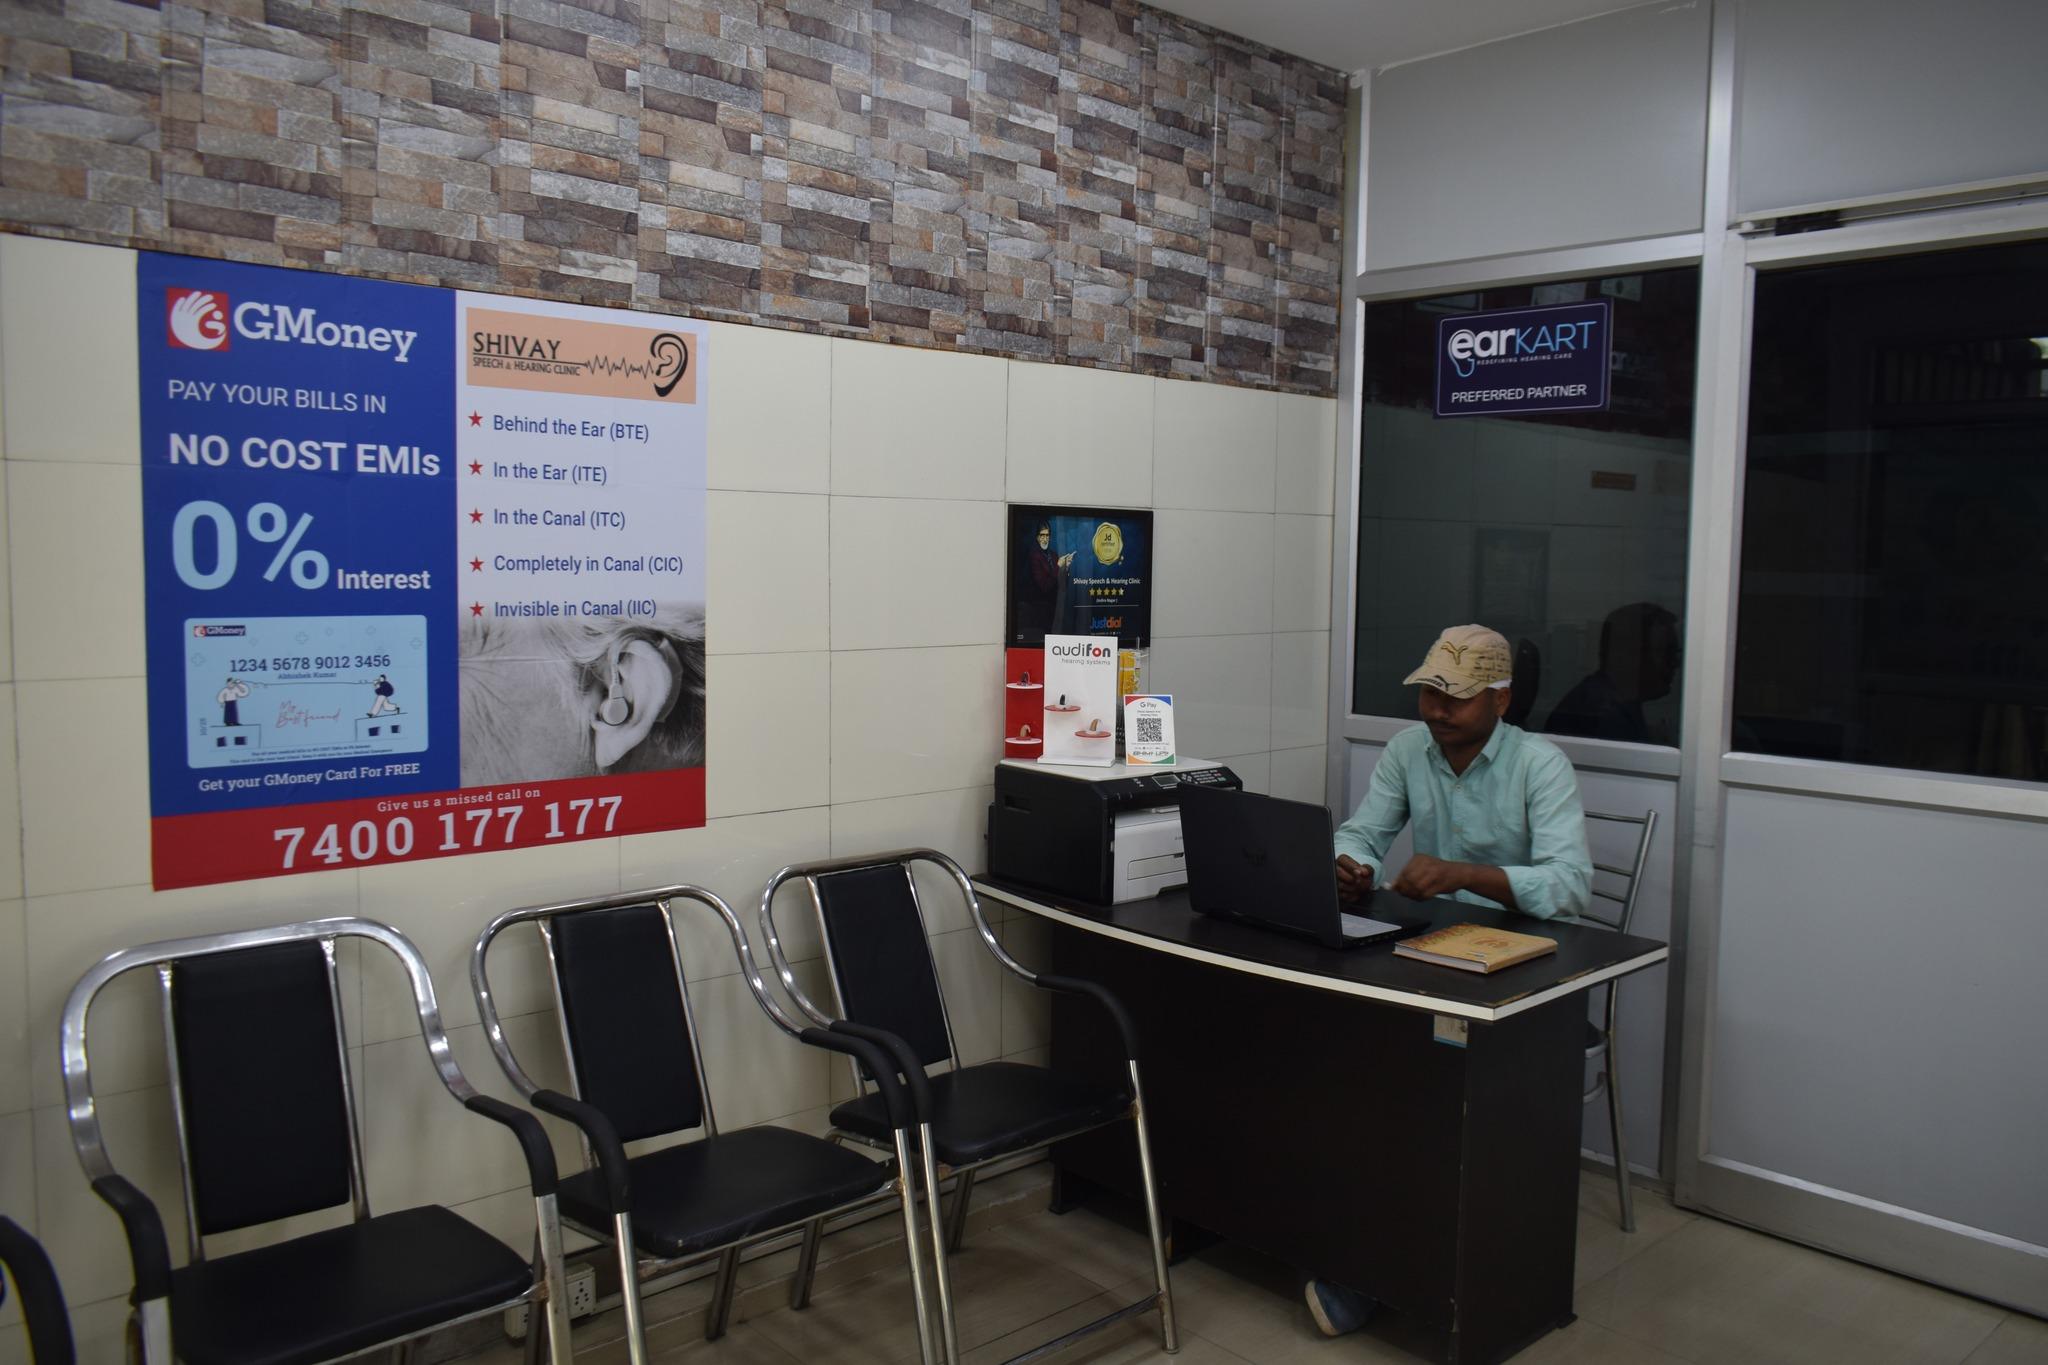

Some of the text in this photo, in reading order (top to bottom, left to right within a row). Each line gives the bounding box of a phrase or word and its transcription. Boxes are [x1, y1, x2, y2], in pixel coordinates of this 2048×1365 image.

[233, 301, 417, 362] GMoney
[1448, 320, 1597, 360] earKART
[473, 332, 561, 359] SHIVAY
[473, 356, 504, 369] SPEECH
[514, 360, 552, 373] HEARING
[554, 364, 581, 376] CLINIC
[1477, 357, 1518, 365] REDEFINING
[1520, 354, 1551, 362] HEARING
[168, 379, 386, 413] PAY YOUR BILLS IN
[1451, 383, 1587, 403] PREFERRED PARTNER
[493, 414, 649, 444] Behind the Ear (BTE)
[170, 433, 440, 476] NO COST EMIs
[493, 462, 607, 486] In the Ear (ITE)
[493, 508, 626, 531] In the Canal (ITC)
[172, 500, 431, 590] 0% Interest
[494, 555, 683, 575] Completely in Canal (CIC)
[1128, 577, 1140, 585] Clinic
[494, 599, 657, 618] Invisible in Canal (IIC)
[207, 626, 245, 636] GMoney
[1052, 643, 1111, 658] audifon
[230, 655, 391, 673] 1234 5678 9012 3456
[198, 763, 420, 792] Get your GMoney Card For FREE
[377, 789, 541, 812] Give us a missed call on
[273, 795, 622, 869] 7400 177 177
